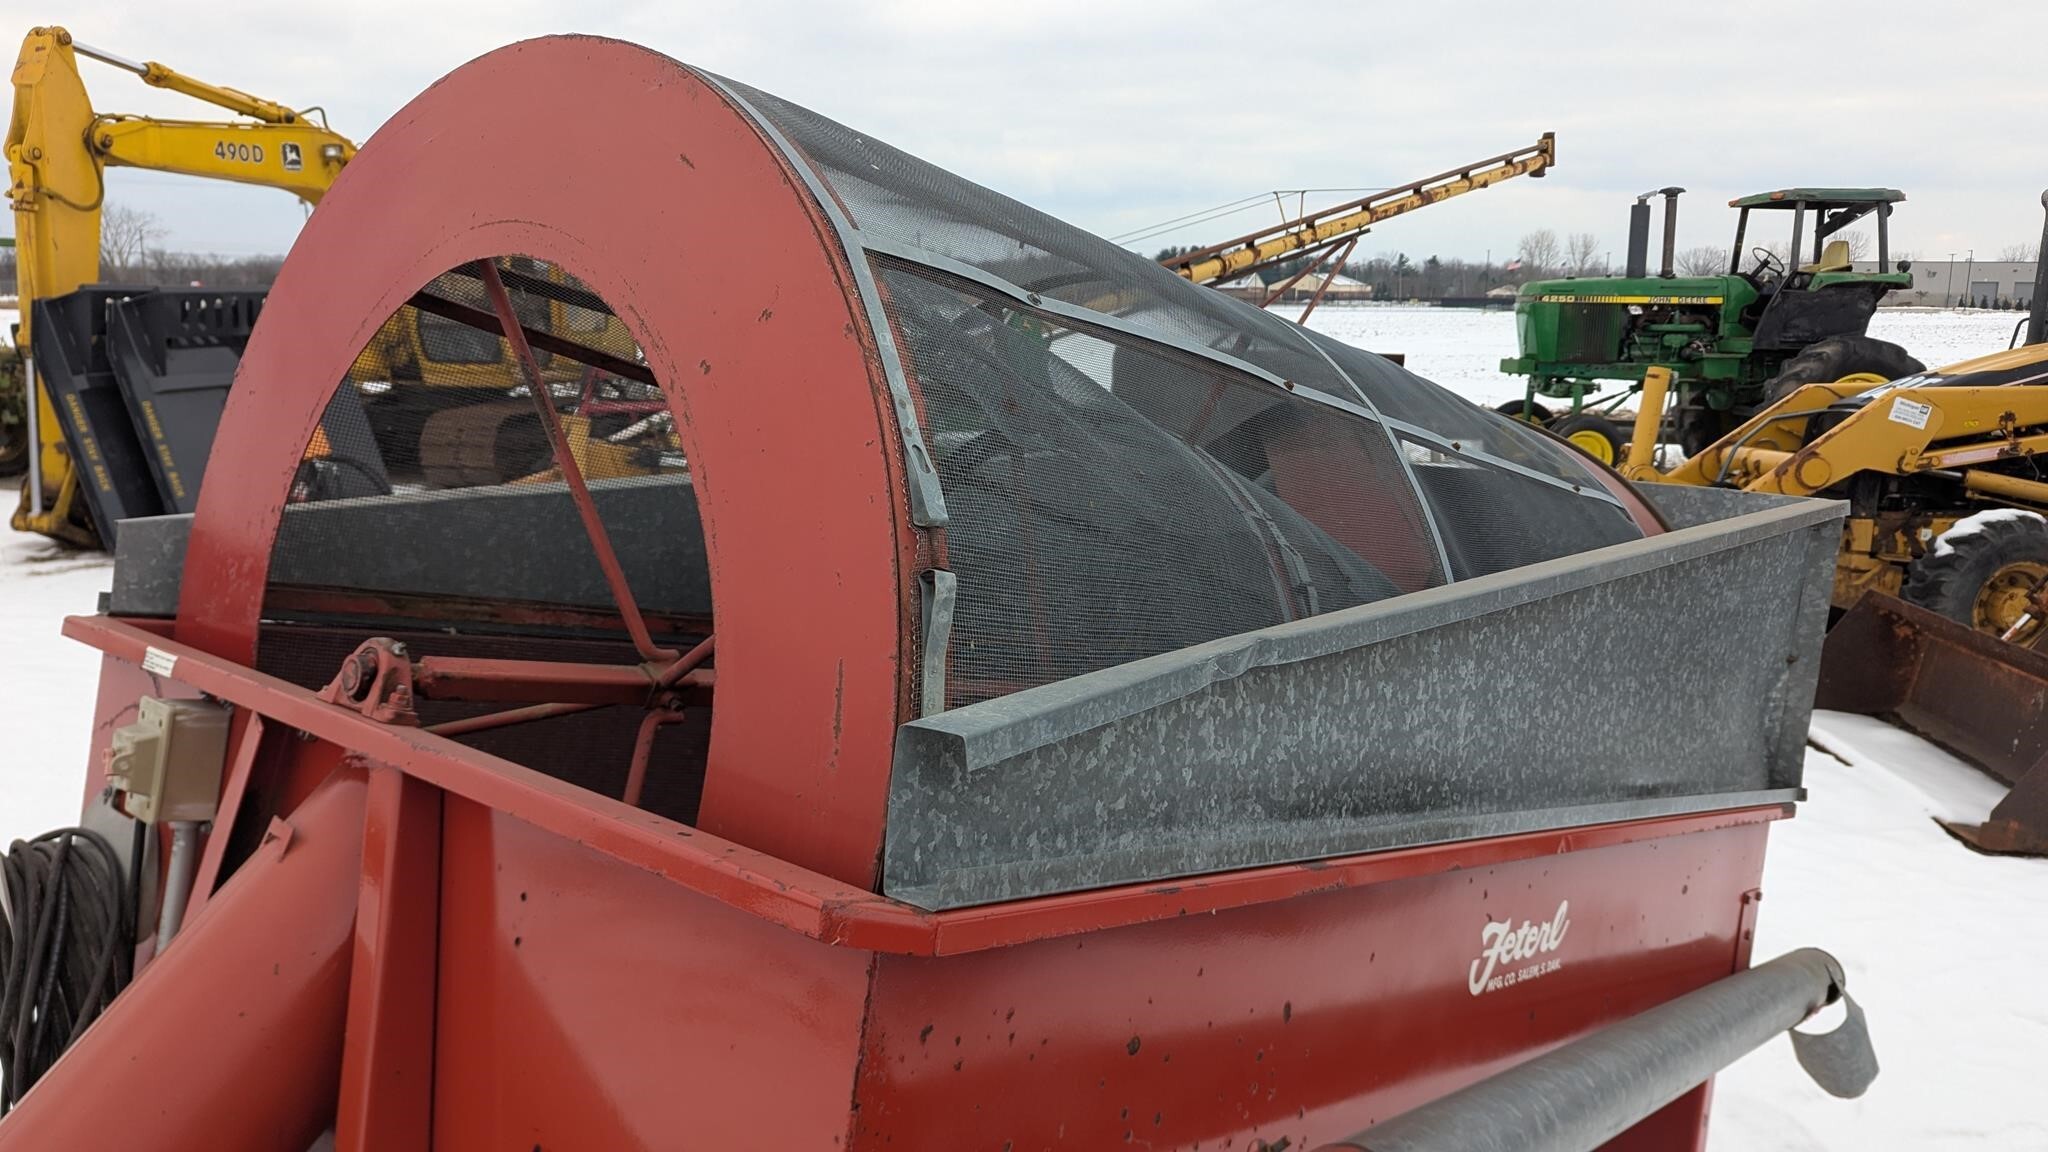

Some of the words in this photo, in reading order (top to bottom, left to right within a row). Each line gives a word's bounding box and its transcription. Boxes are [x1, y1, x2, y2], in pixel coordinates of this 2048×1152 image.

[215, 141, 264, 163] 490D
[1541, 295, 1575, 303] 4250
[1648, 296, 1671, 304] JOHN
[1679, 296, 1706, 304] DEERE
[65, 393, 88, 433] DANGER
[83, 437, 99, 461] STAY
[94, 464, 111, 492] BACK
[141, 400, 164, 440] DANGER
[159, 443, 175, 467] STAY
[1468, 899, 1571, 996] Feterl
